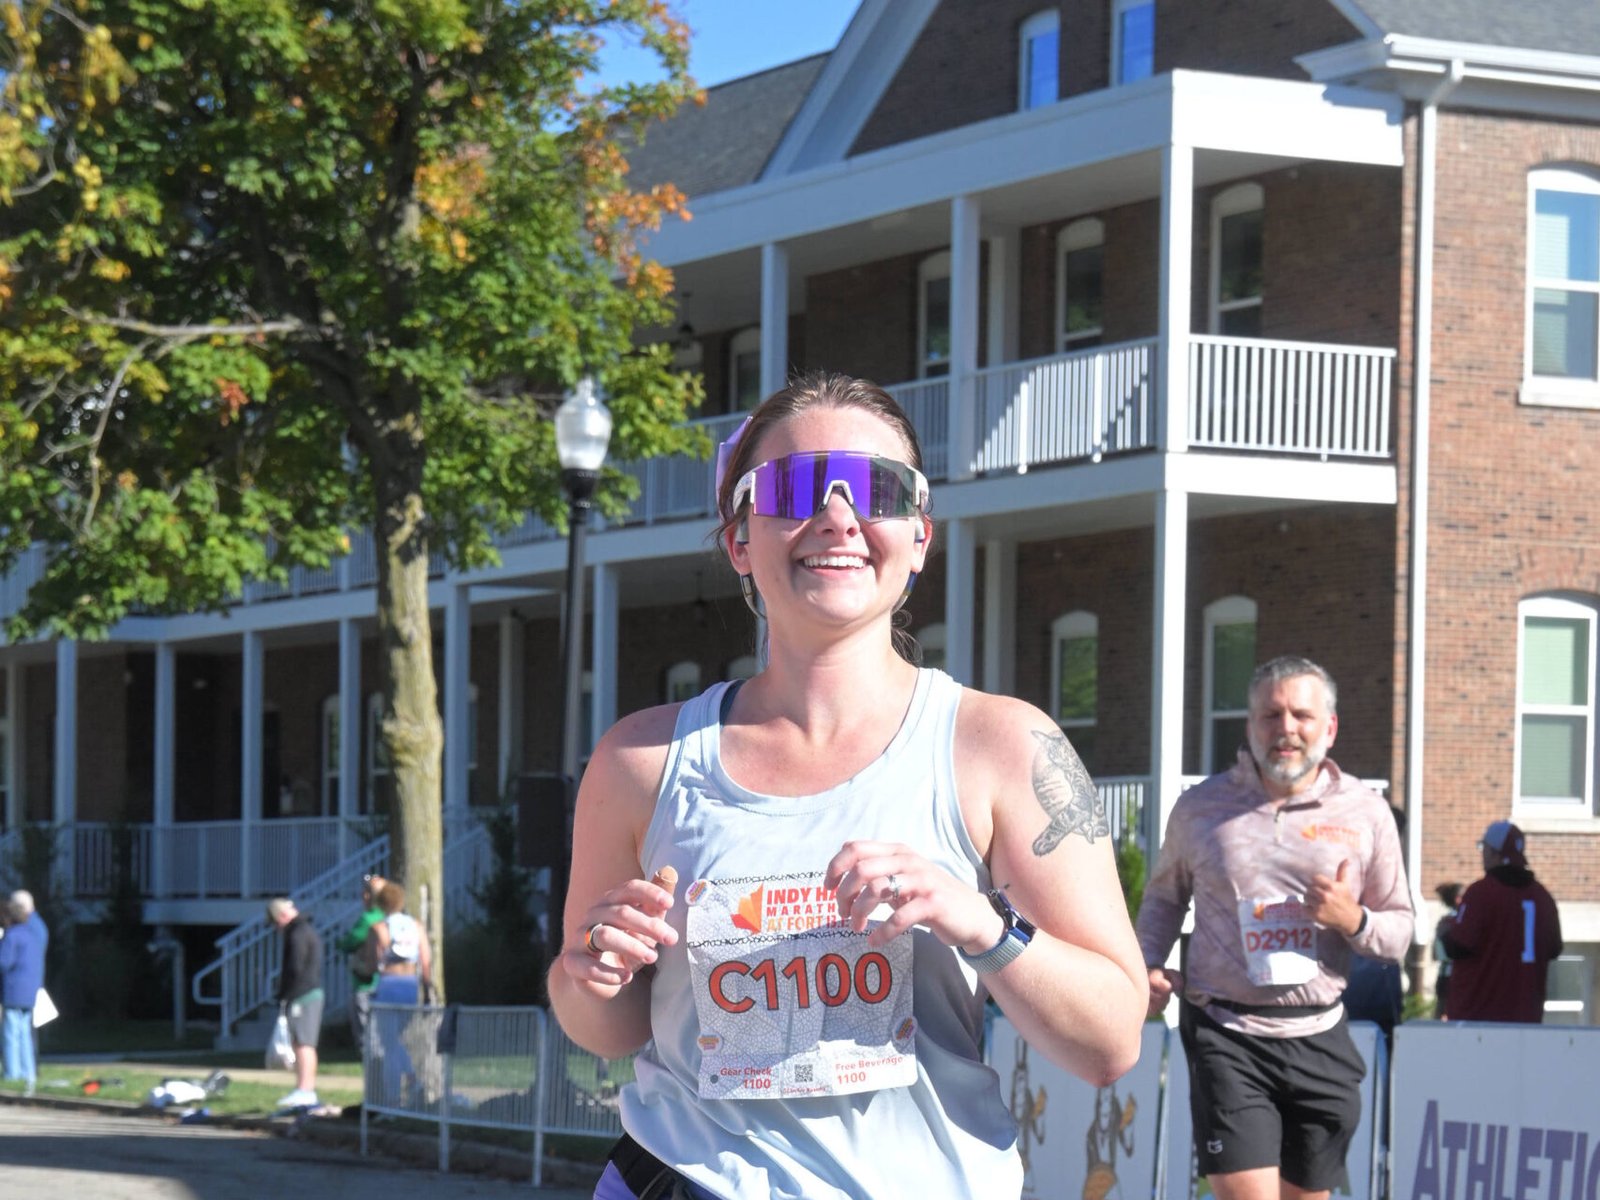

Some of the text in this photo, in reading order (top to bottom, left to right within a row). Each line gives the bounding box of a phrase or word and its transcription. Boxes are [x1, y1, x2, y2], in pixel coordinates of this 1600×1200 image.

[767, 886, 837, 905] INDY HA
[766, 903, 836, 917] MARATH
[787, 915, 823, 932] FORT
[1522, 900, 1536, 963] 1
[1245, 927, 1313, 953] D2912
[708, 951, 893, 1014] C1100
[720, 1066, 772, 1076] Gear Check
[835, 1056, 904, 1071] Free Beverage
[744, 1078, 772, 1090] 1100
[837, 1071, 867, 1084] 1100
